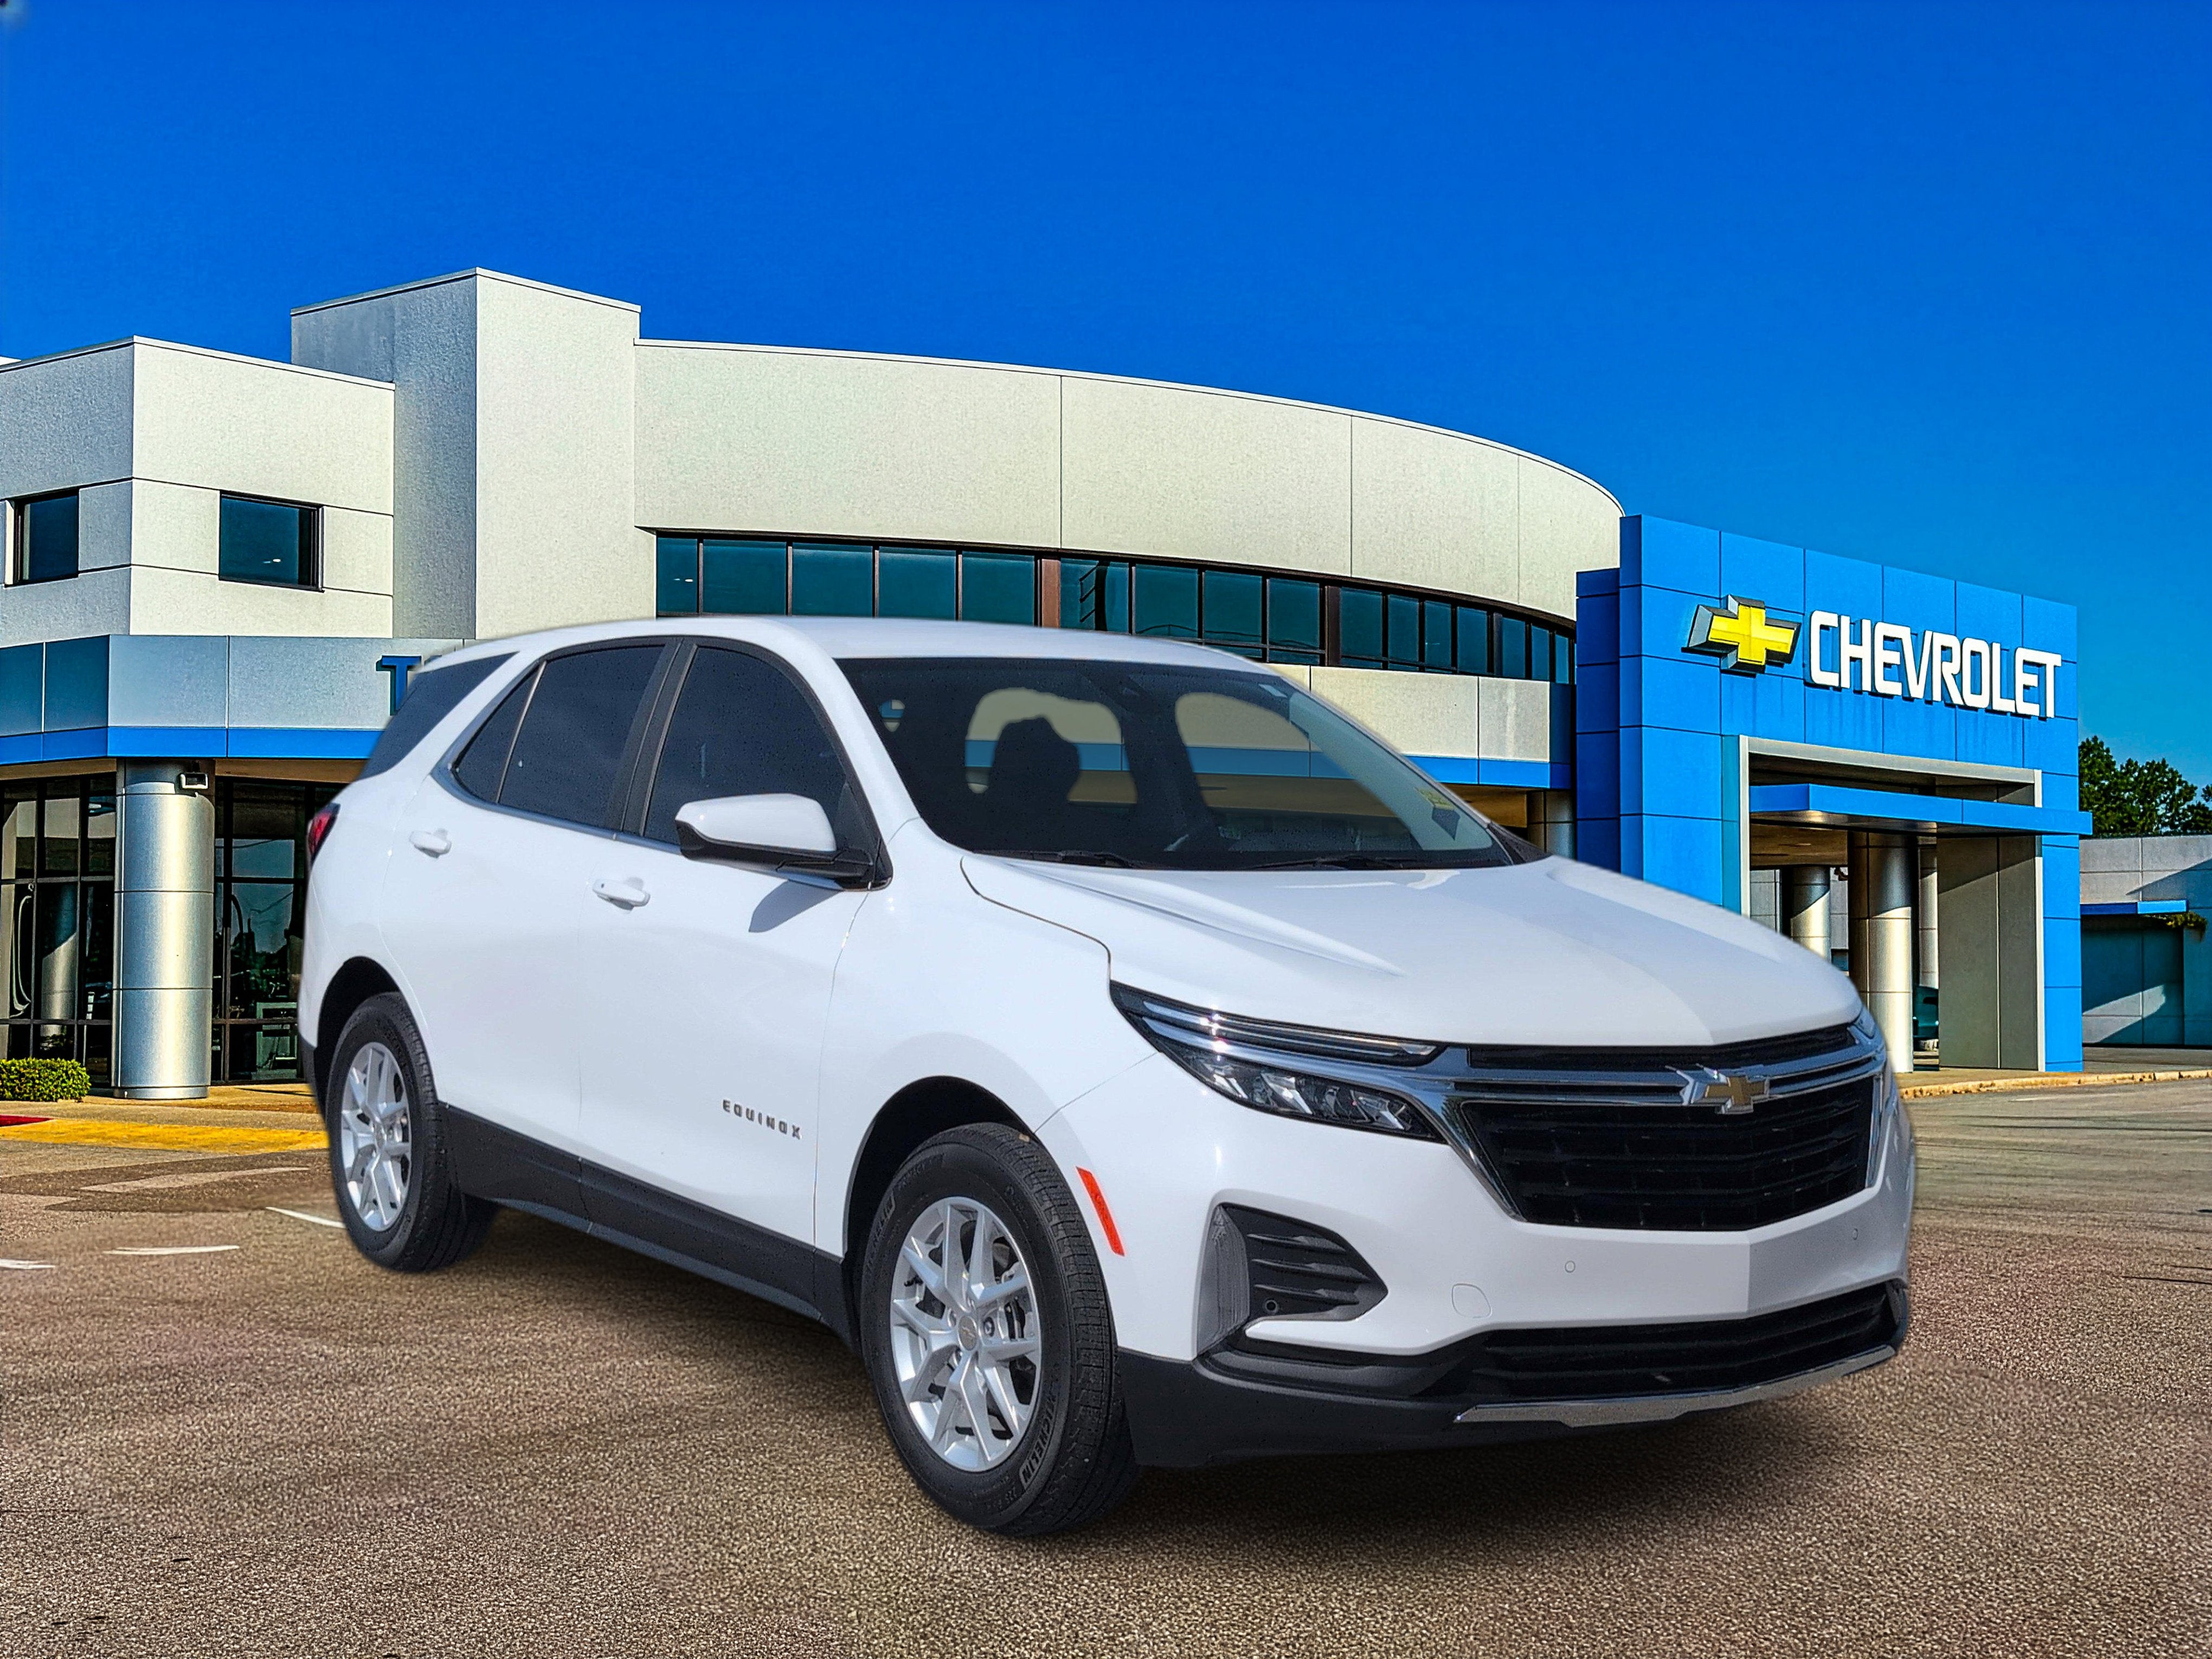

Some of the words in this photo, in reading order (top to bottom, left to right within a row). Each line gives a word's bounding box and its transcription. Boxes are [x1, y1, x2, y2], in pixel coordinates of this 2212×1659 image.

[376, 654, 442, 716] T
[1810, 610, 2062, 718] CHEVROLET
[723, 1099, 801, 1140] EQUINOX
